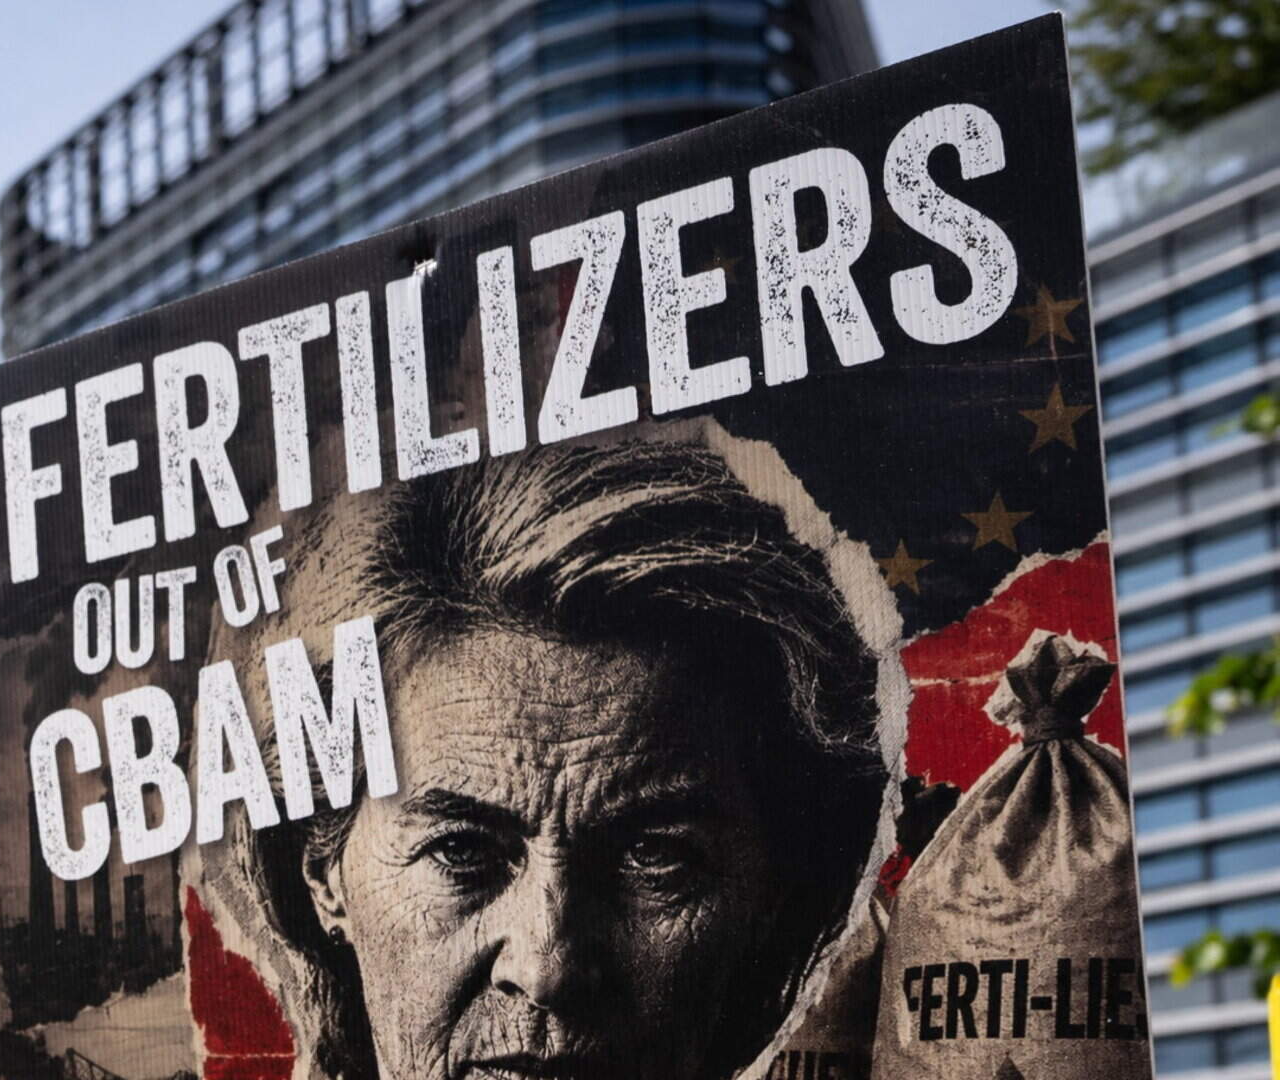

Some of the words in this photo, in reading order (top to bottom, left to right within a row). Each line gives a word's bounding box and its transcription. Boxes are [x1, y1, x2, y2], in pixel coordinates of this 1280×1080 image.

[1, 101, 1018, 584] FERTILIZERS
[73, 566, 197, 675] OUT
[213, 525, 287, 628] OF
[30, 615, 399, 881] CBAM
[903, 957, 1149, 1041] FERTI-LIE
